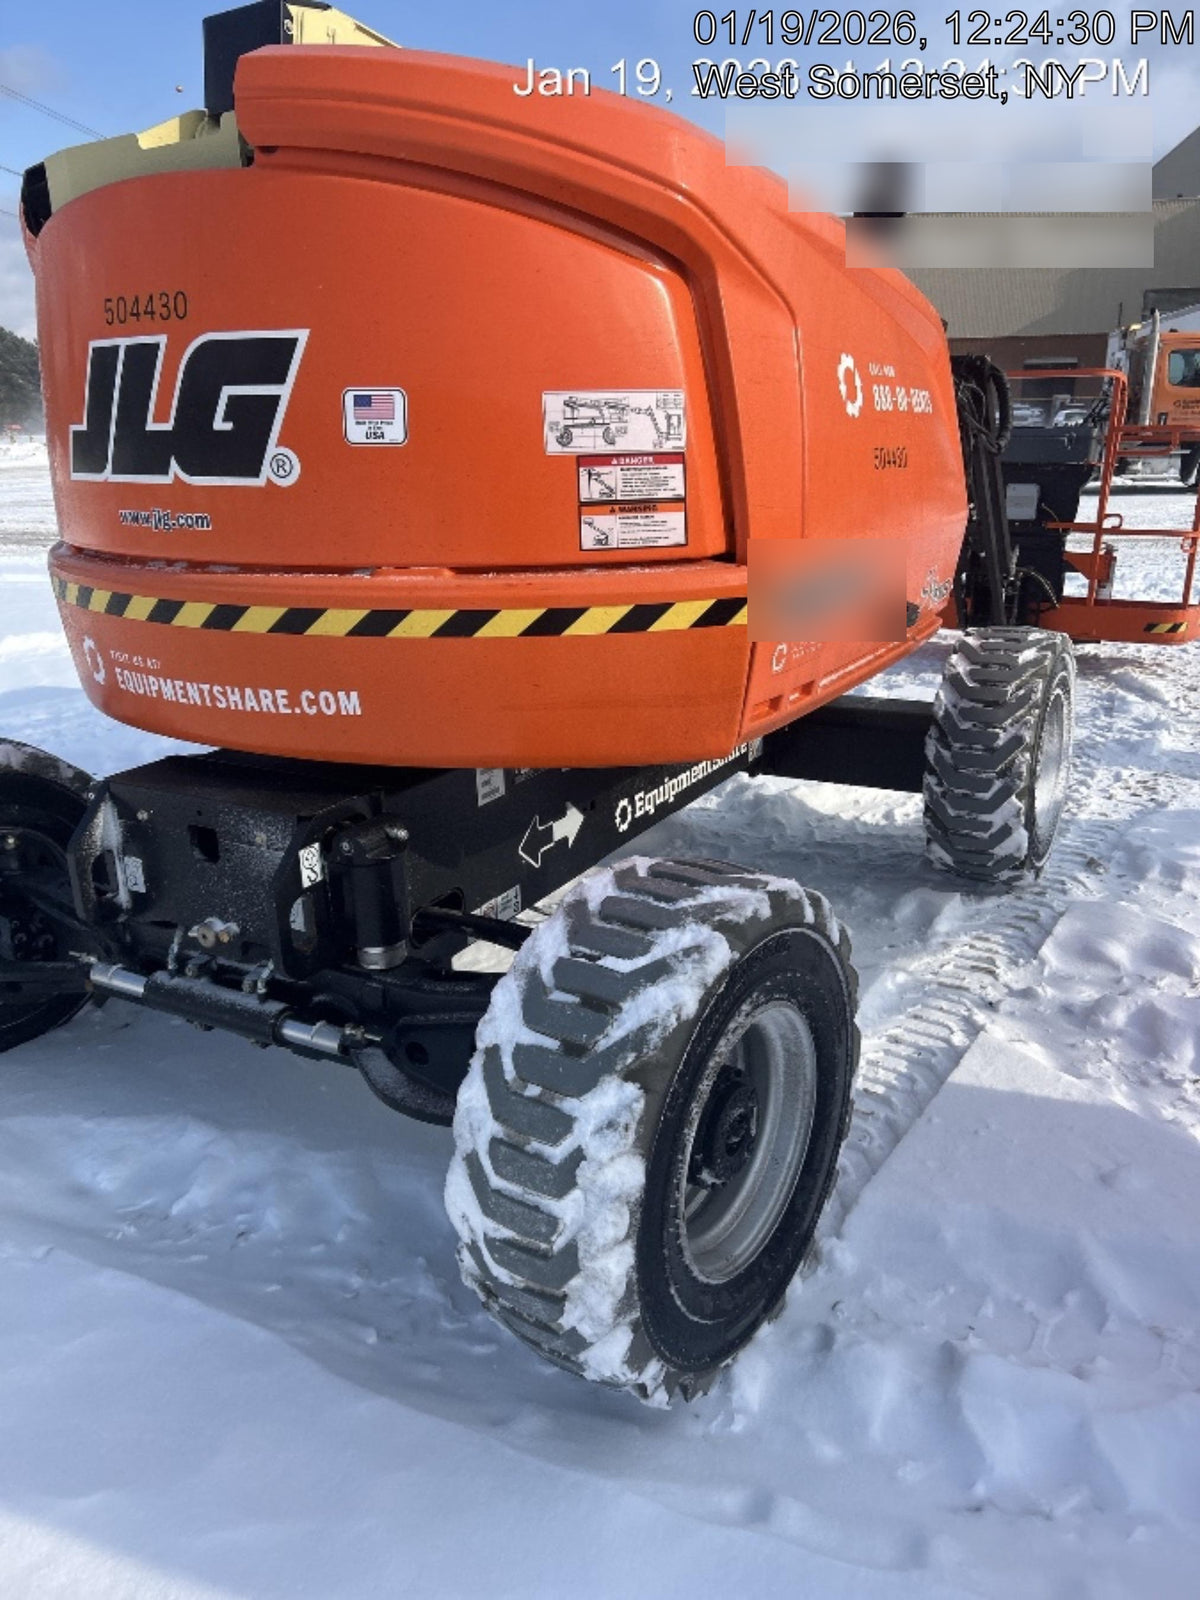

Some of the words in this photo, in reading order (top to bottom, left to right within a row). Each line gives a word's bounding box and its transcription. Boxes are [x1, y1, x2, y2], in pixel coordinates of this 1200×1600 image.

[104, 290, 188, 326] 504430
[69, 328, 311, 488] JLG
[365, 431, 385, 440] USA
[618, 456, 655, 465] DANGER
[119, 508, 212, 532] www.jlg.com
[115, 667, 361, 716] EQUIPMENTSHARE.COM
